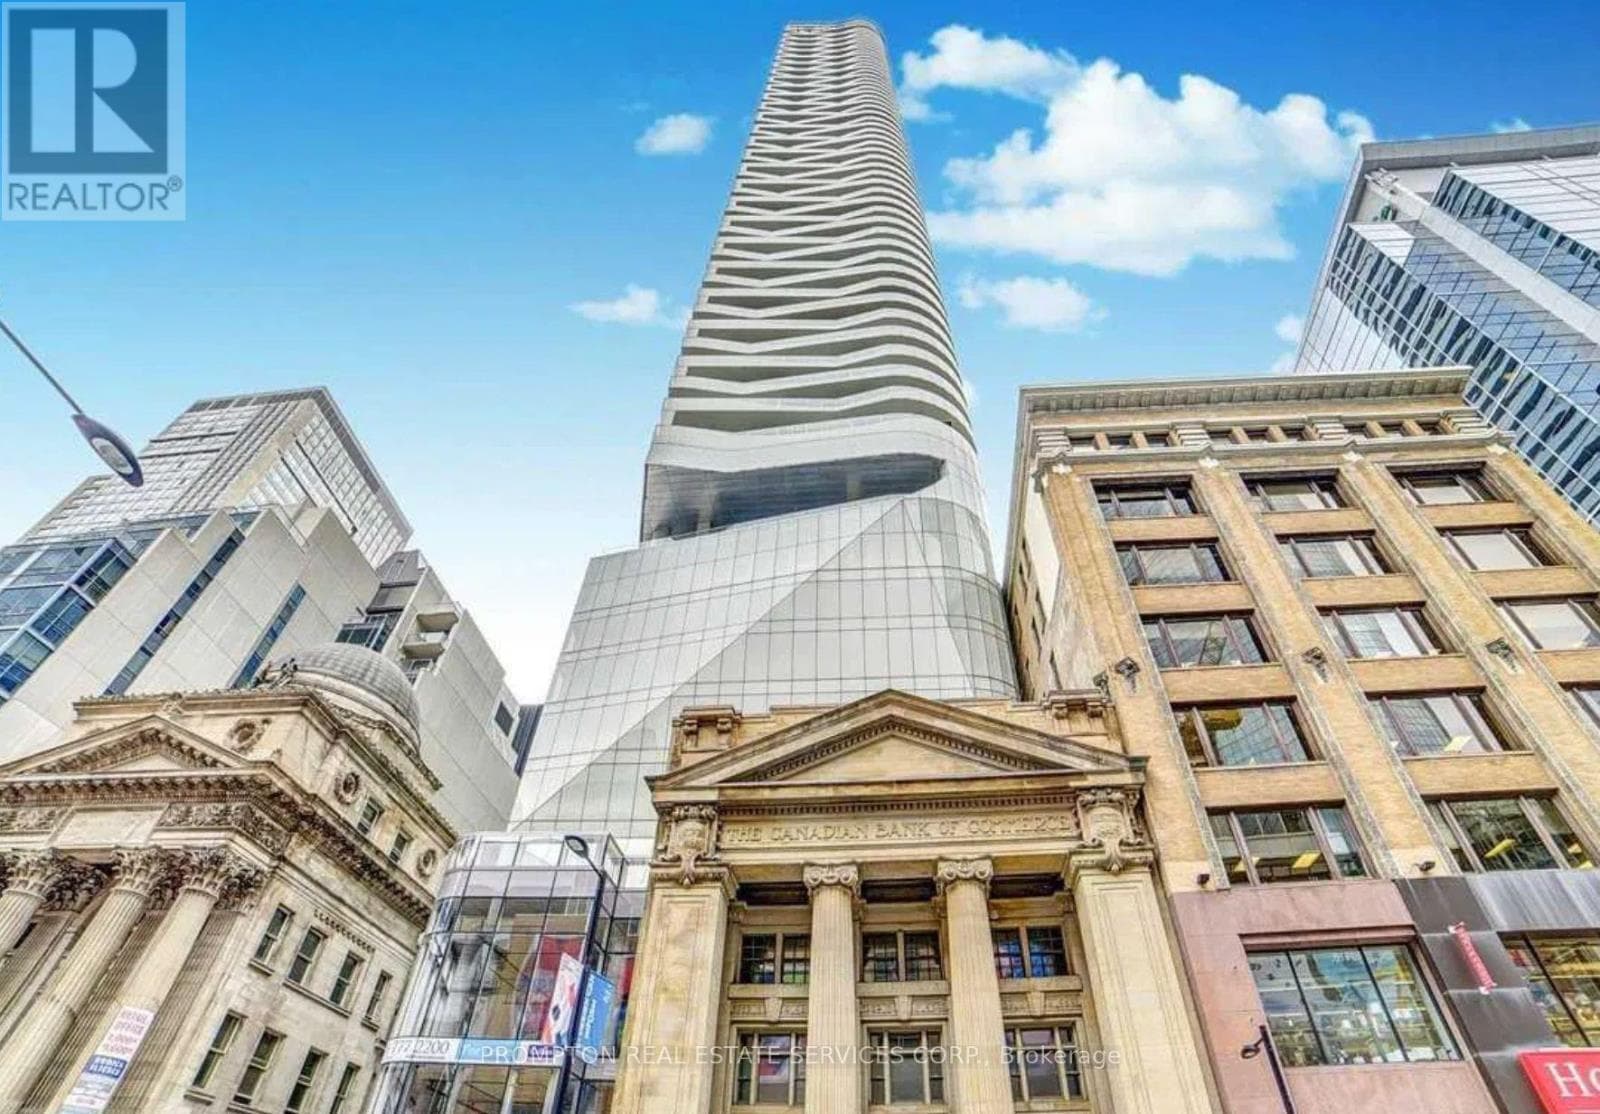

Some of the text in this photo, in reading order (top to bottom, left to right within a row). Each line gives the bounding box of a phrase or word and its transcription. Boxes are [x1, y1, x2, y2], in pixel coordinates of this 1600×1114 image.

[727, 826, 762, 842] THE
[771, 824, 869, 841] CANADIAN
[876, 822, 931, 839] BANK
[940, 820, 960, 836] OF
